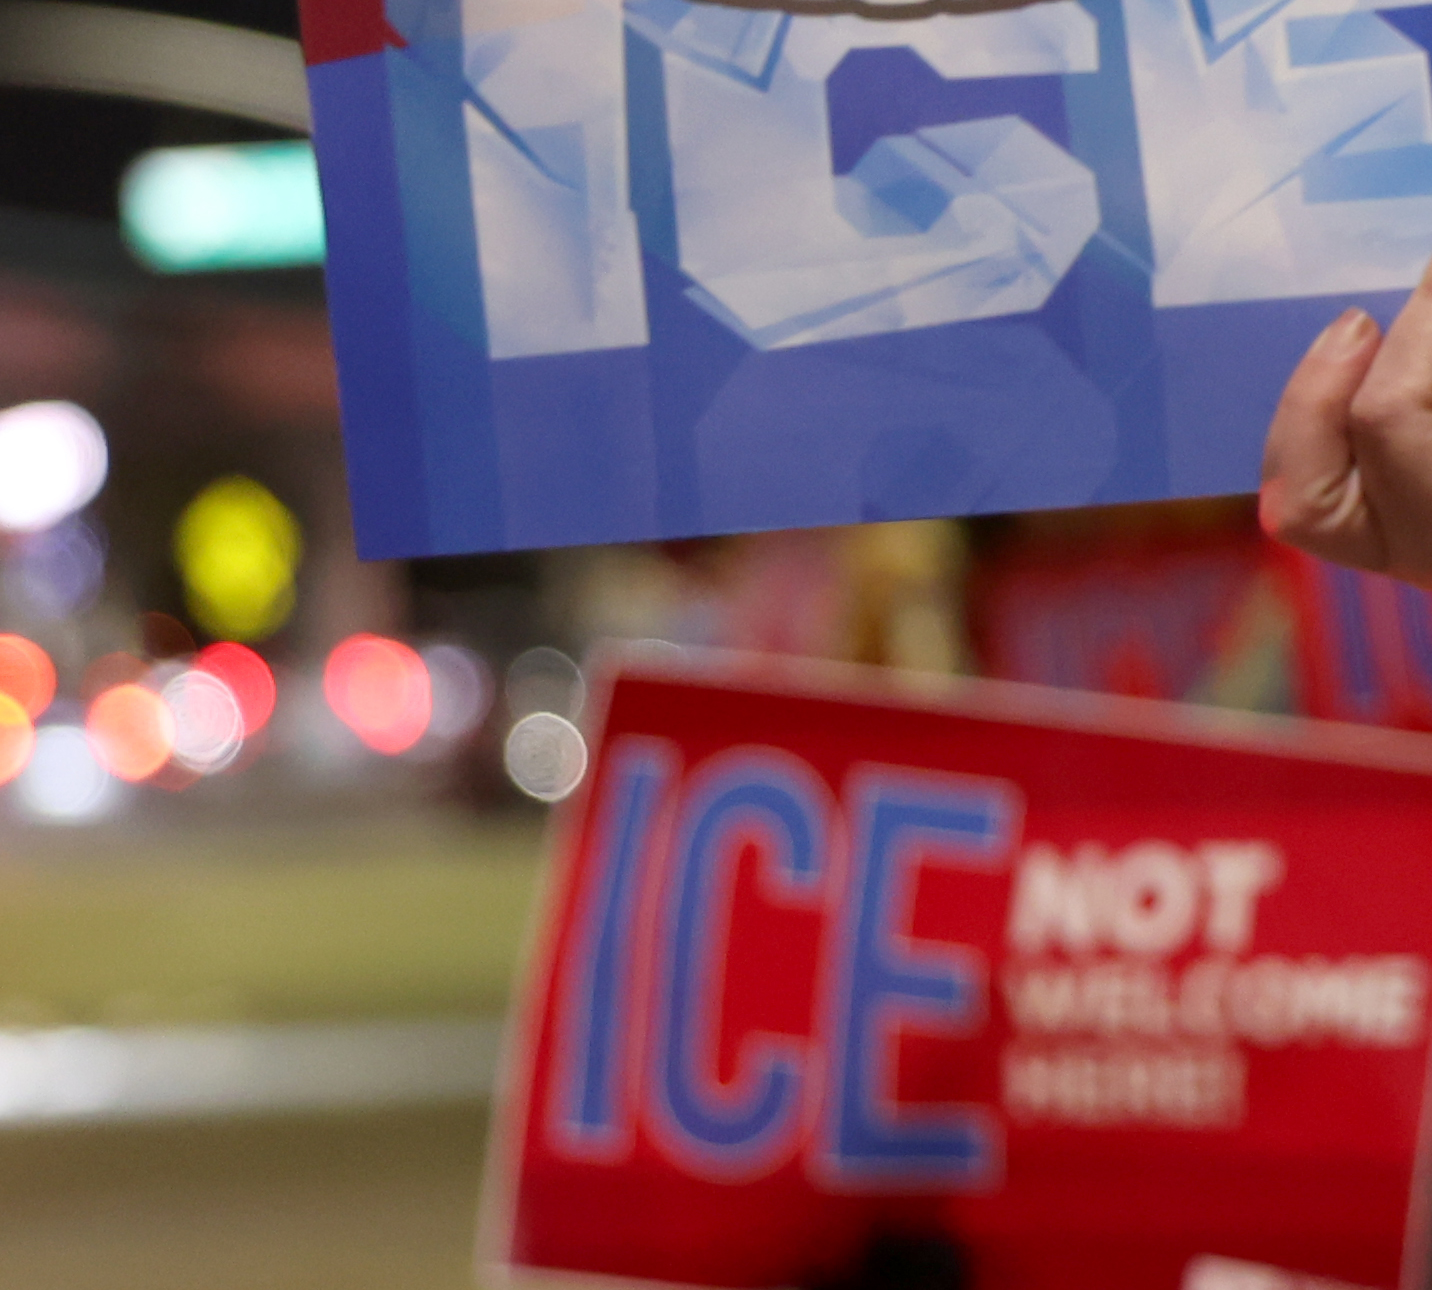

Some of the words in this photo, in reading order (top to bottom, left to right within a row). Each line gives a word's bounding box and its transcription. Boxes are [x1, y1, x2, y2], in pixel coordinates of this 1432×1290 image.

[540, 732, 1022, 1195] ICE
[1009, 839, 1284, 955] NOT
[1009, 953, 1432, 1050] WELCOME
